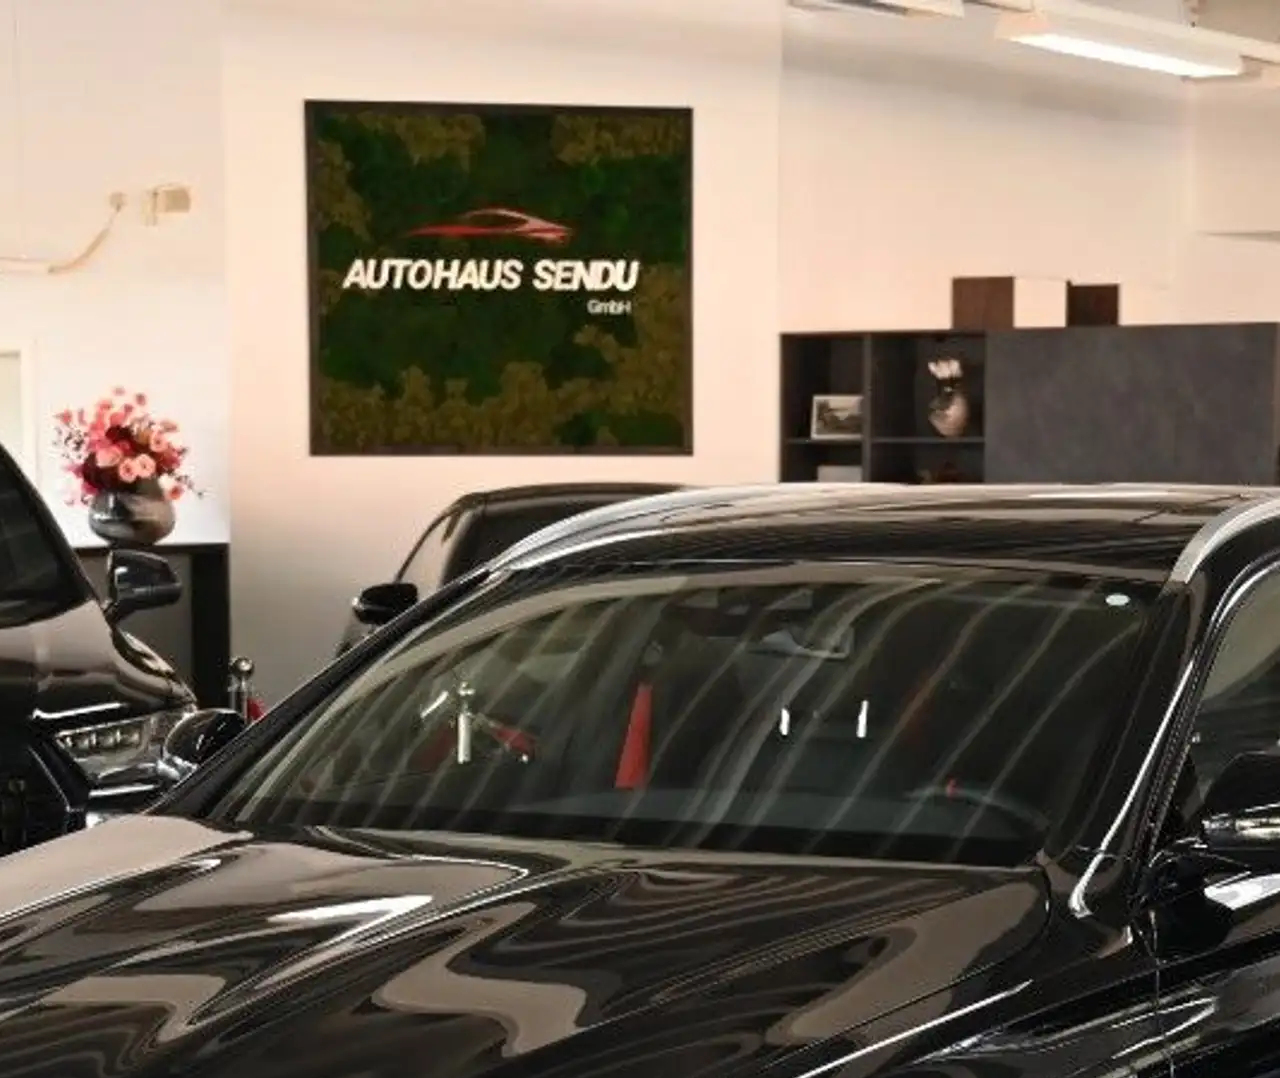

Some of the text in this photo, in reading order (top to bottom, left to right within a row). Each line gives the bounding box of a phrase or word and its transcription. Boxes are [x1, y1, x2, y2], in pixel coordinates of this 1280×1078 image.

[342, 259, 640, 291] AUTOHAUS SENDU
[587, 300, 631, 315] GmbH
